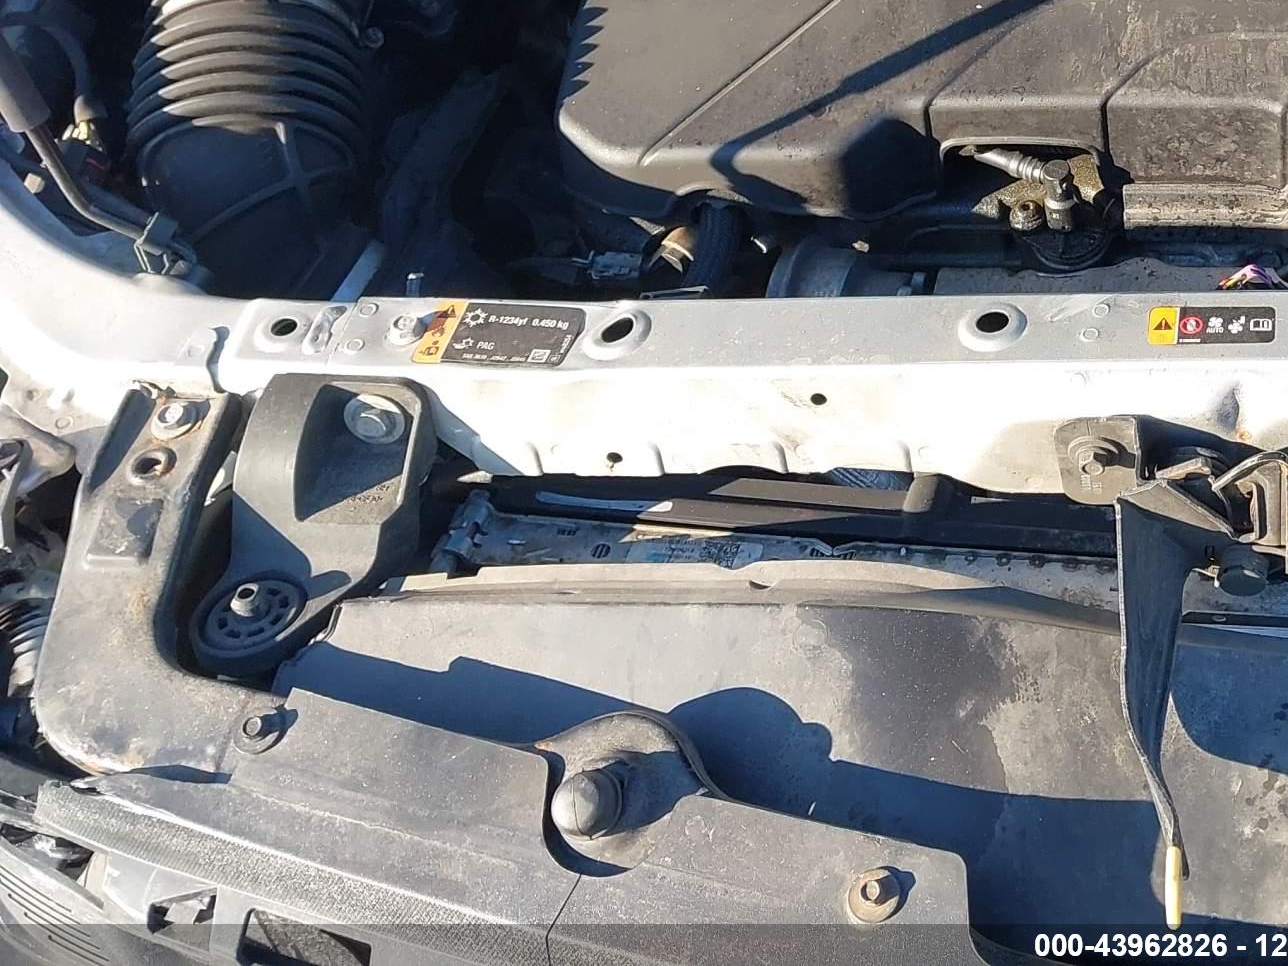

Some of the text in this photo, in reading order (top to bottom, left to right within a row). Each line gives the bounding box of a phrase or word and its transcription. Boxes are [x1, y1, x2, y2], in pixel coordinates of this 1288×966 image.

[488, 315, 569, 330] R-1234yf 0.450 kg
[476, 341, 495, 350] PAG
